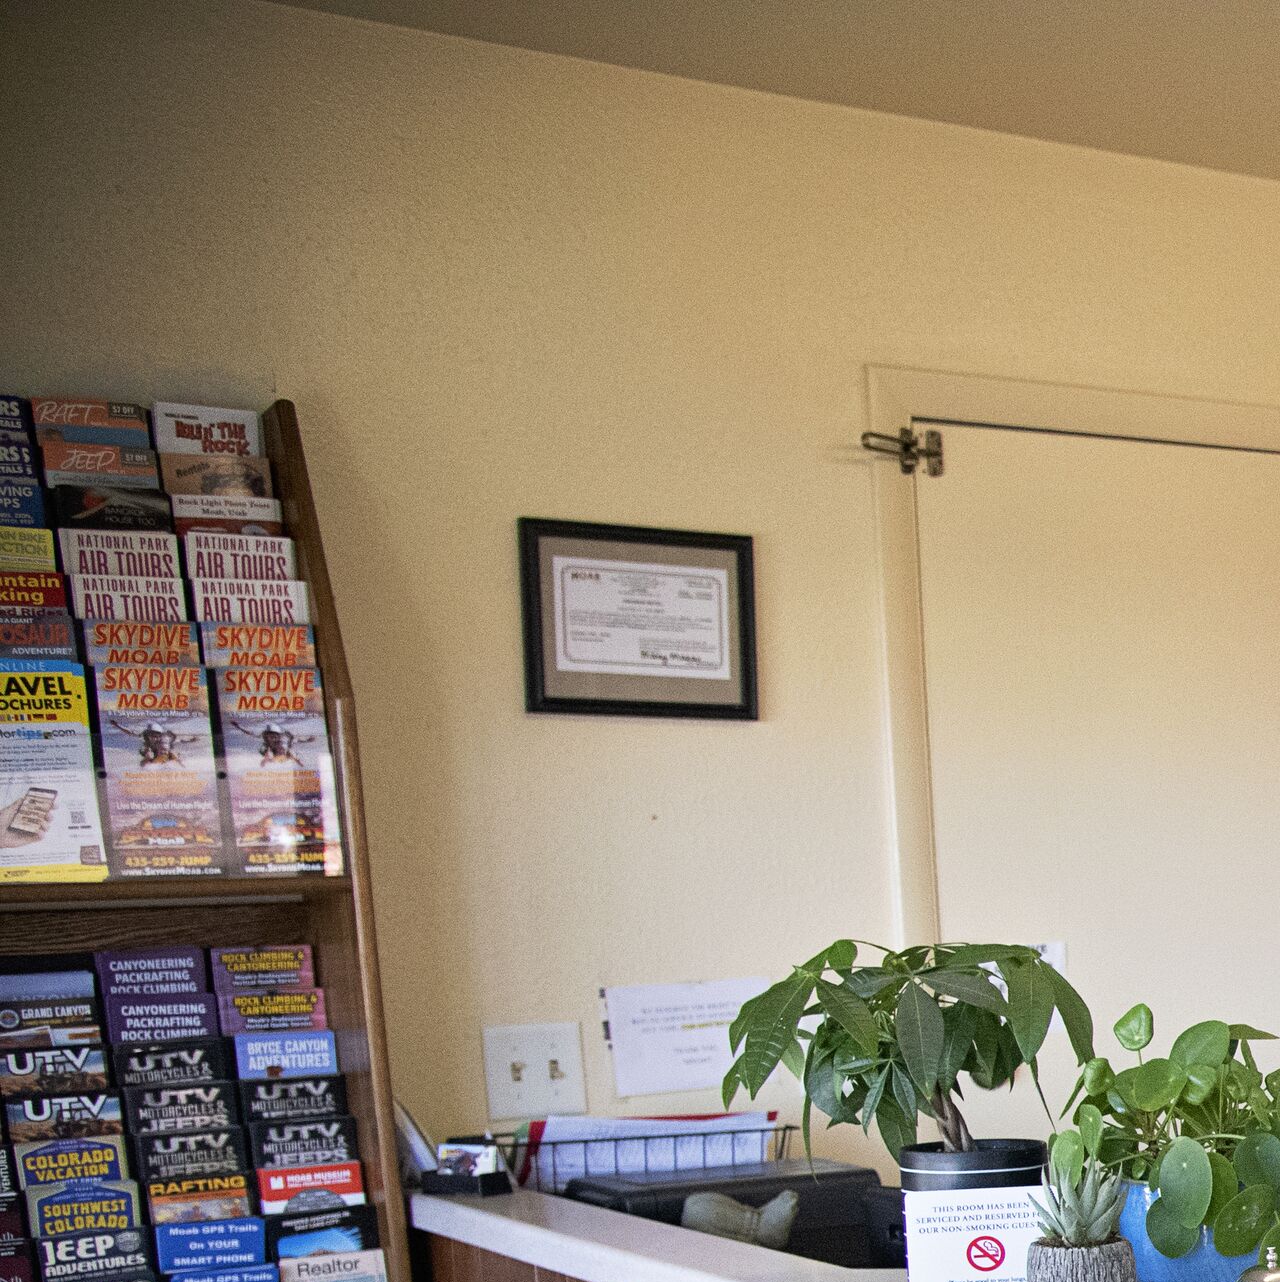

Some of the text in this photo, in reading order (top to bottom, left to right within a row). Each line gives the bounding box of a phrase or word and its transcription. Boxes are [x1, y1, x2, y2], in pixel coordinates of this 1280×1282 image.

[78, 535, 170, 551] NATIONAL PARK
[195, 536, 284, 554] NATIONAL PARK
[79, 550, 174, 578] AIR TOURS
[196, 552, 287, 580] AIR TOURS
[0, 574, 61, 588] ntain
[83, 577, 175, 595] NATIONAL PARK
[202, 581, 290, 597] NATIONAL PARK
[85, 593, 180, 622] AIR TOURS
[203, 596, 294, 624] AIR TOURS
[95, 623, 190, 647] SKYDIVE
[216, 626, 308, 650] SKYDIVE
[12, 647, 73, 656] ADVENTURE?
[109, 649, 180, 665] MOAB
[229, 651, 297, 666] MOAB
[0, 676, 73, 697] AVEL
[104, 667, 200, 692] SKYDIVE
[224, 670, 315, 693] SKYDIVE
[118, 694, 190, 710] MOAB
[238, 695, 306, 710] MOAB
[109, 956, 194, 972] CANYONEERING
[115, 969, 190, 984] PACKRAFTING
[110, 981, 197, 995] ROCK CLIMBING
[21, 1004, 91, 1020] GRAND CANYON
[121, 1003, 206, 1017] CANYONEERING
[126, 1016, 201, 1029] PACKRAFTING
[121, 1027, 208, 1041] ROCK CLIMBING
[247, 1039, 329, 1055] BRYCE CANYON
[6, 1048, 90, 1075] UTV
[129, 1048, 205, 1072] UTV
[248, 1052, 330, 1071] ADVENTURES
[124, 1063, 200, 1084] MOTORCYCLES
[144, 1087, 221, 1107] UTV
[256, 1080, 330, 1100] UTV
[23, 1095, 108, 1122] UTV
[139, 1102, 216, 1120] MOTORCYCLES
[251, 1096, 324, 1113] MOTORCYCLES
[141, 1113, 231, 1133] JEEPS
[268, 1122, 342, 1143] UTV
[154, 1132, 231, 1153] UTV
[263, 1137, 337, 1154] MOTORCYCLES
[25, 1148, 115, 1171] COLORADO
[149, 1149, 227, 1168] MOTORCYCLES
[264, 1148, 349, 1169] JEEPS
[35, 1164, 109, 1182] VACATION
[150, 1175, 245, 1196] RAFTING
[43, 1199, 127, 1218] SOUTHWEST
[932, 1201, 1030, 1213] THIS ROOM HAS BEEN
[44, 1214, 128, 1236] COLORADO
[916, 1211, 1030, 1225] SERVICED AND RESERVED
[169, 1223, 259, 1237] Moab GPS Trails
[918, 1220, 1040, 1235] OUR NON-SMOKING GUEST
[42, 1233, 115, 1267] JEEP
[207, 1238, 240, 1250] YOUR
[45, 1252, 147, 1279] ADVENTURES
[174, 1253, 255, 1267] SMART PHONE
[297, 1257, 361, 1278] Realtor
[242, 1272, 273, 1282] Trails
